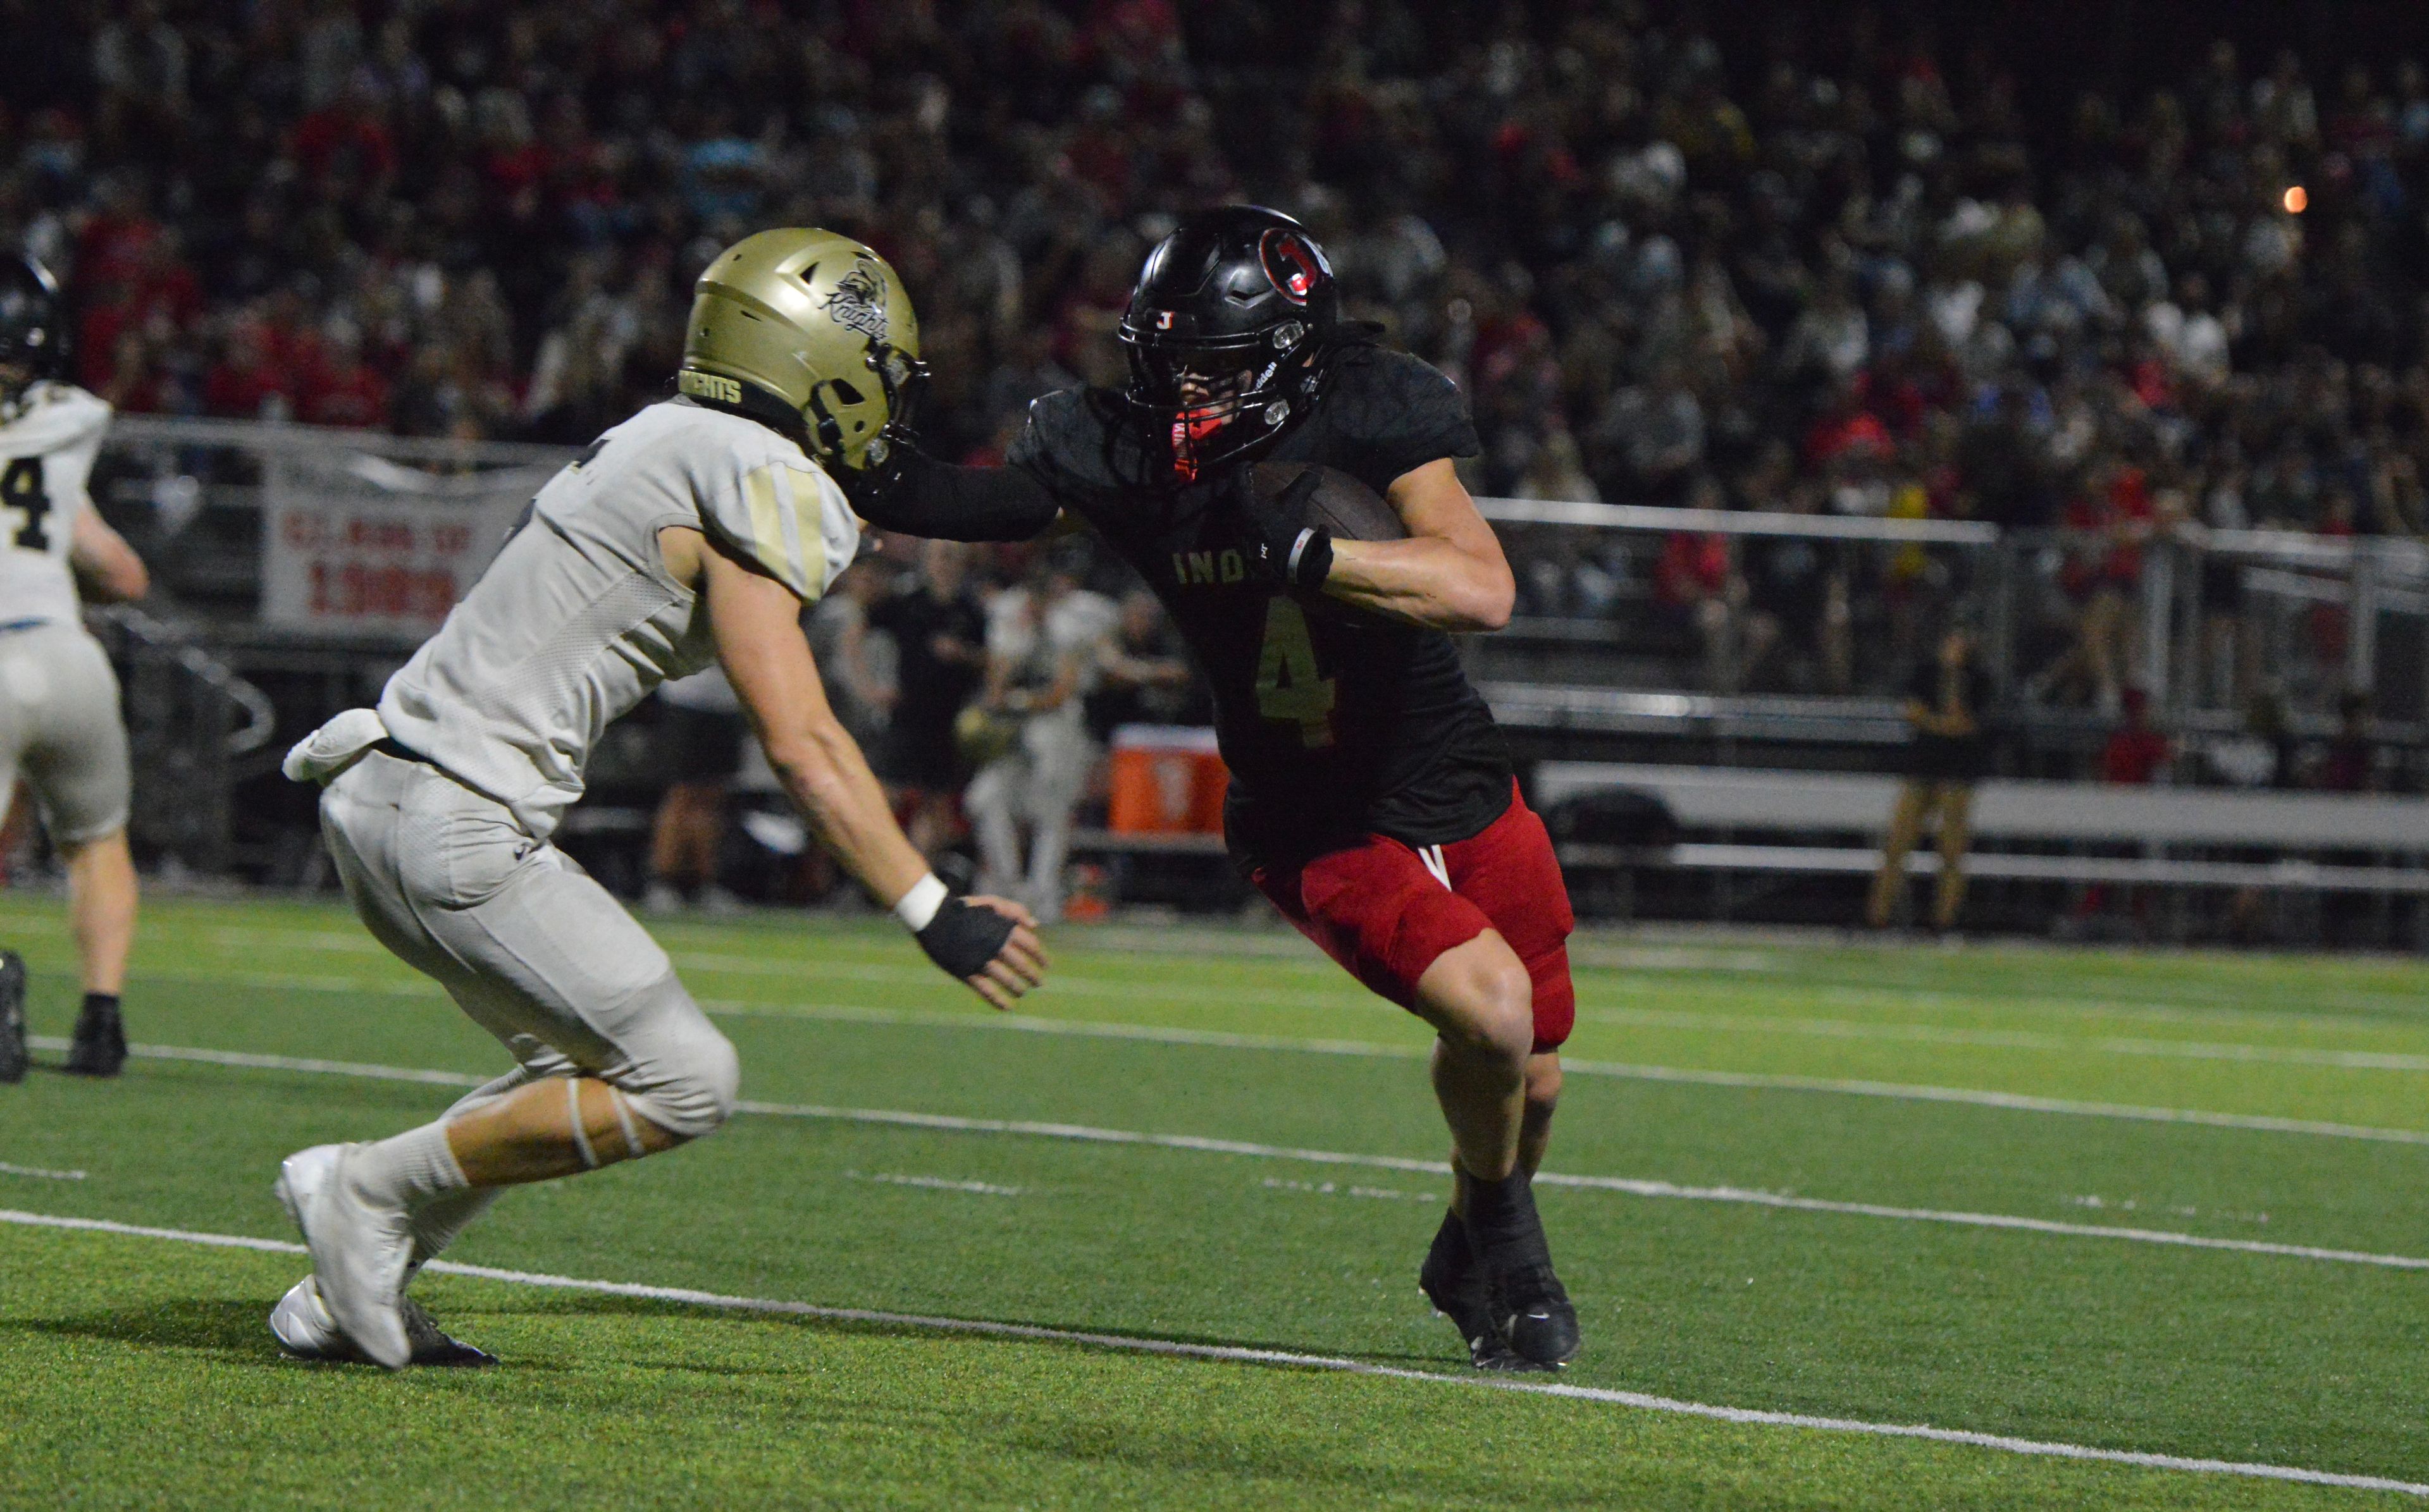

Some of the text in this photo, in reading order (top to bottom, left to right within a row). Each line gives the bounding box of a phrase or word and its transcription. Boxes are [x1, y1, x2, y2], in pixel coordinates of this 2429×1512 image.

[1156, 311, 1175, 330] J
[1254, 361, 1277, 390] ddell
[0, 458, 51, 550] 4
[1173, 549, 1244, 584] IND
[1255, 594, 1335, 749] 4
